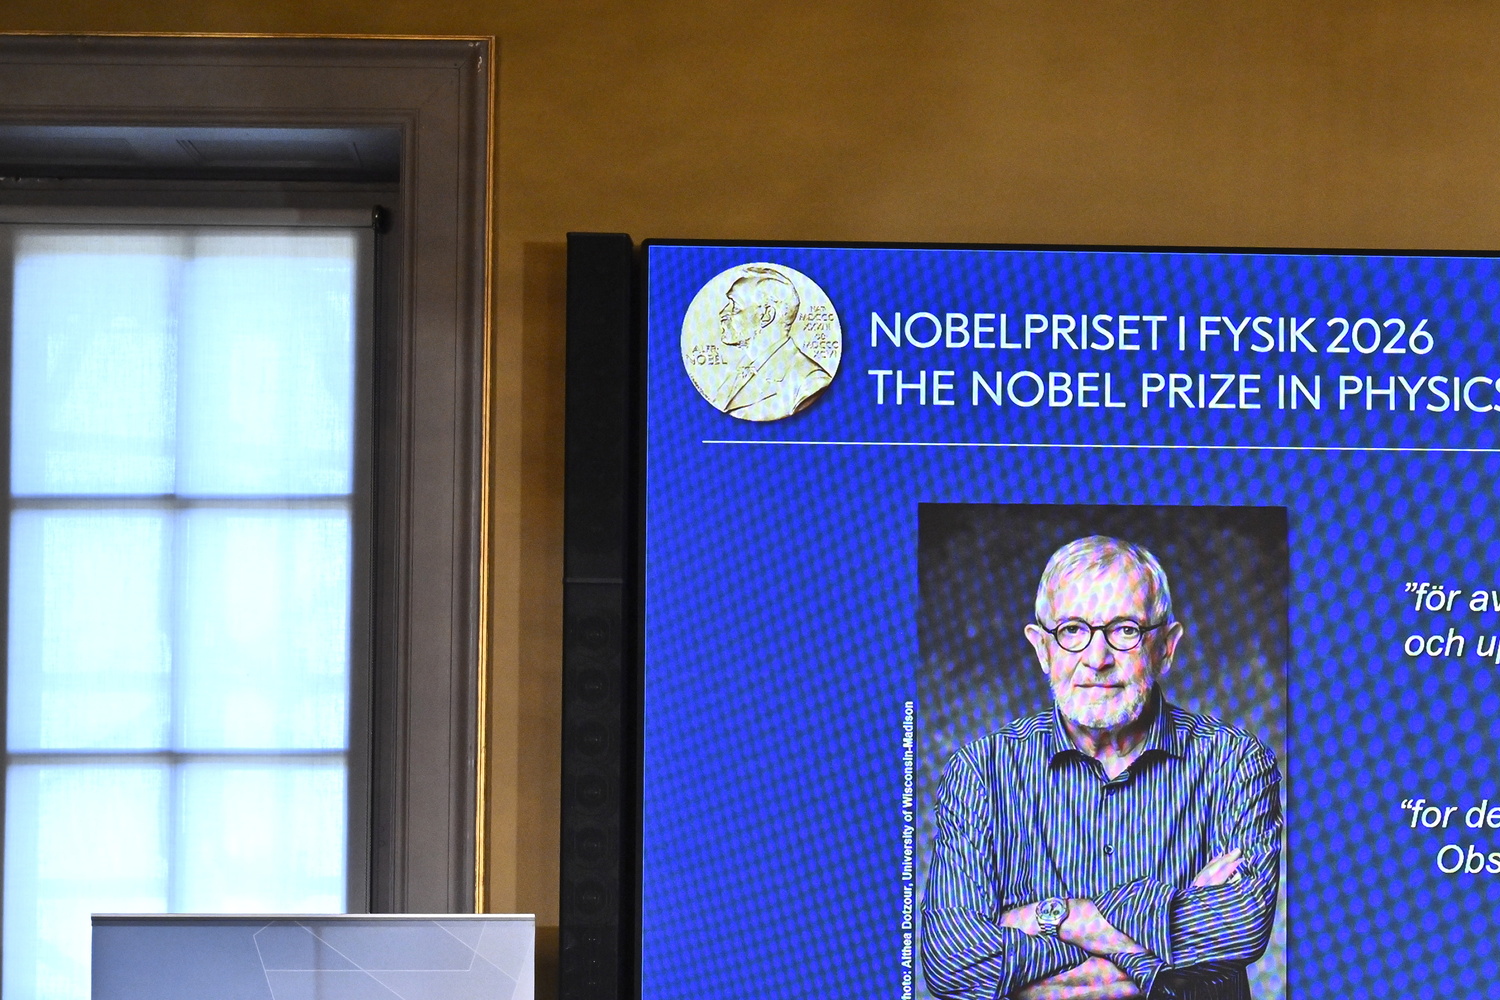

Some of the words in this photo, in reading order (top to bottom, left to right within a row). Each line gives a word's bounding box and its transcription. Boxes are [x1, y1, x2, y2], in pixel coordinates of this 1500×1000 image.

[872, 312, 1167, 350] NOBELPRISET
[1179, 316, 1185, 350] I
[1200, 317, 1317, 352] FYSIK
[1327, 318, 1433, 354] 2026
[868, 370, 954, 405] THE
[973, 371, 1126, 407] NOBEL
[1142, 374, 1260, 409] PRIZE
[1279, 375, 1320, 409] IN
[1405, 628, 1464, 656] och
[903, 806, 912, 822] of
[902, 825, 915, 881] University
[902, 883, 914, 930] Dotzour,
[901, 932, 912, 968] Althea
